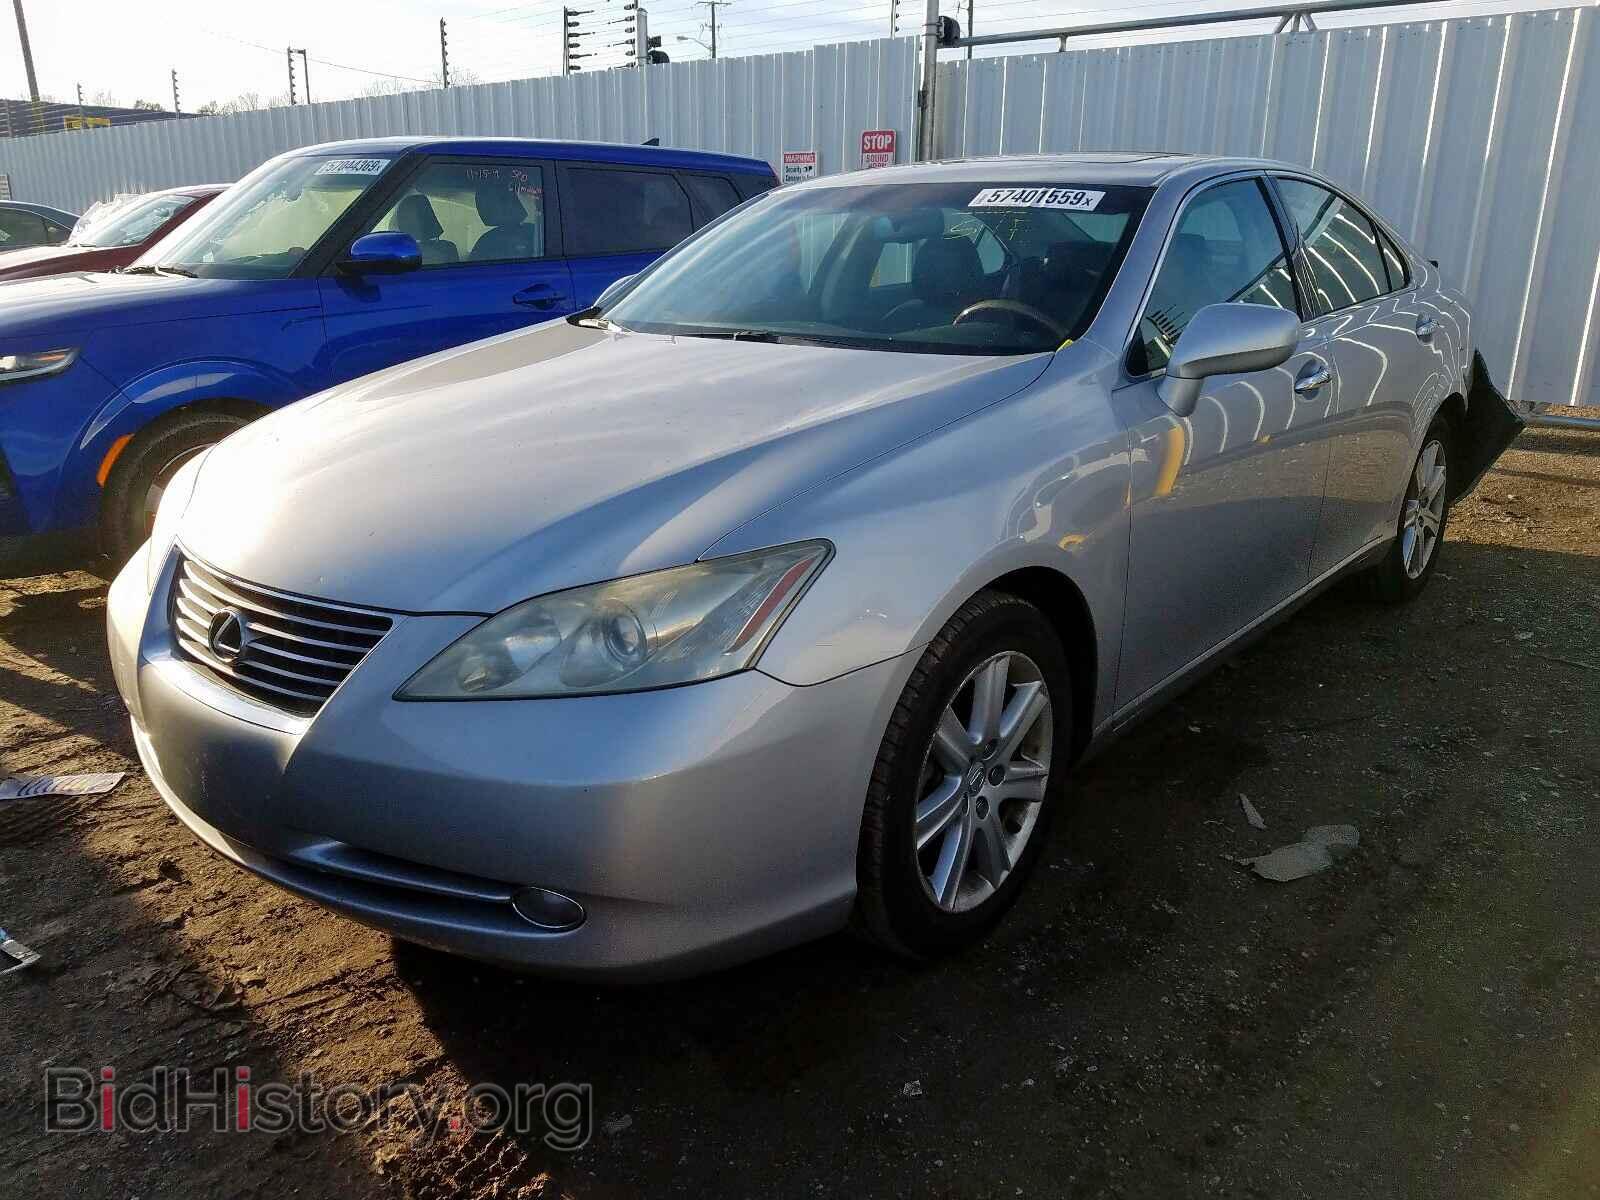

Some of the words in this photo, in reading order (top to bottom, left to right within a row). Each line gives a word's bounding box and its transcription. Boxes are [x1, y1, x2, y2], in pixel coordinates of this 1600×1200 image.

[863, 133, 892, 151] STOP
[785, 153, 815, 163] WARNING
[866, 153, 889, 163] SOUND
